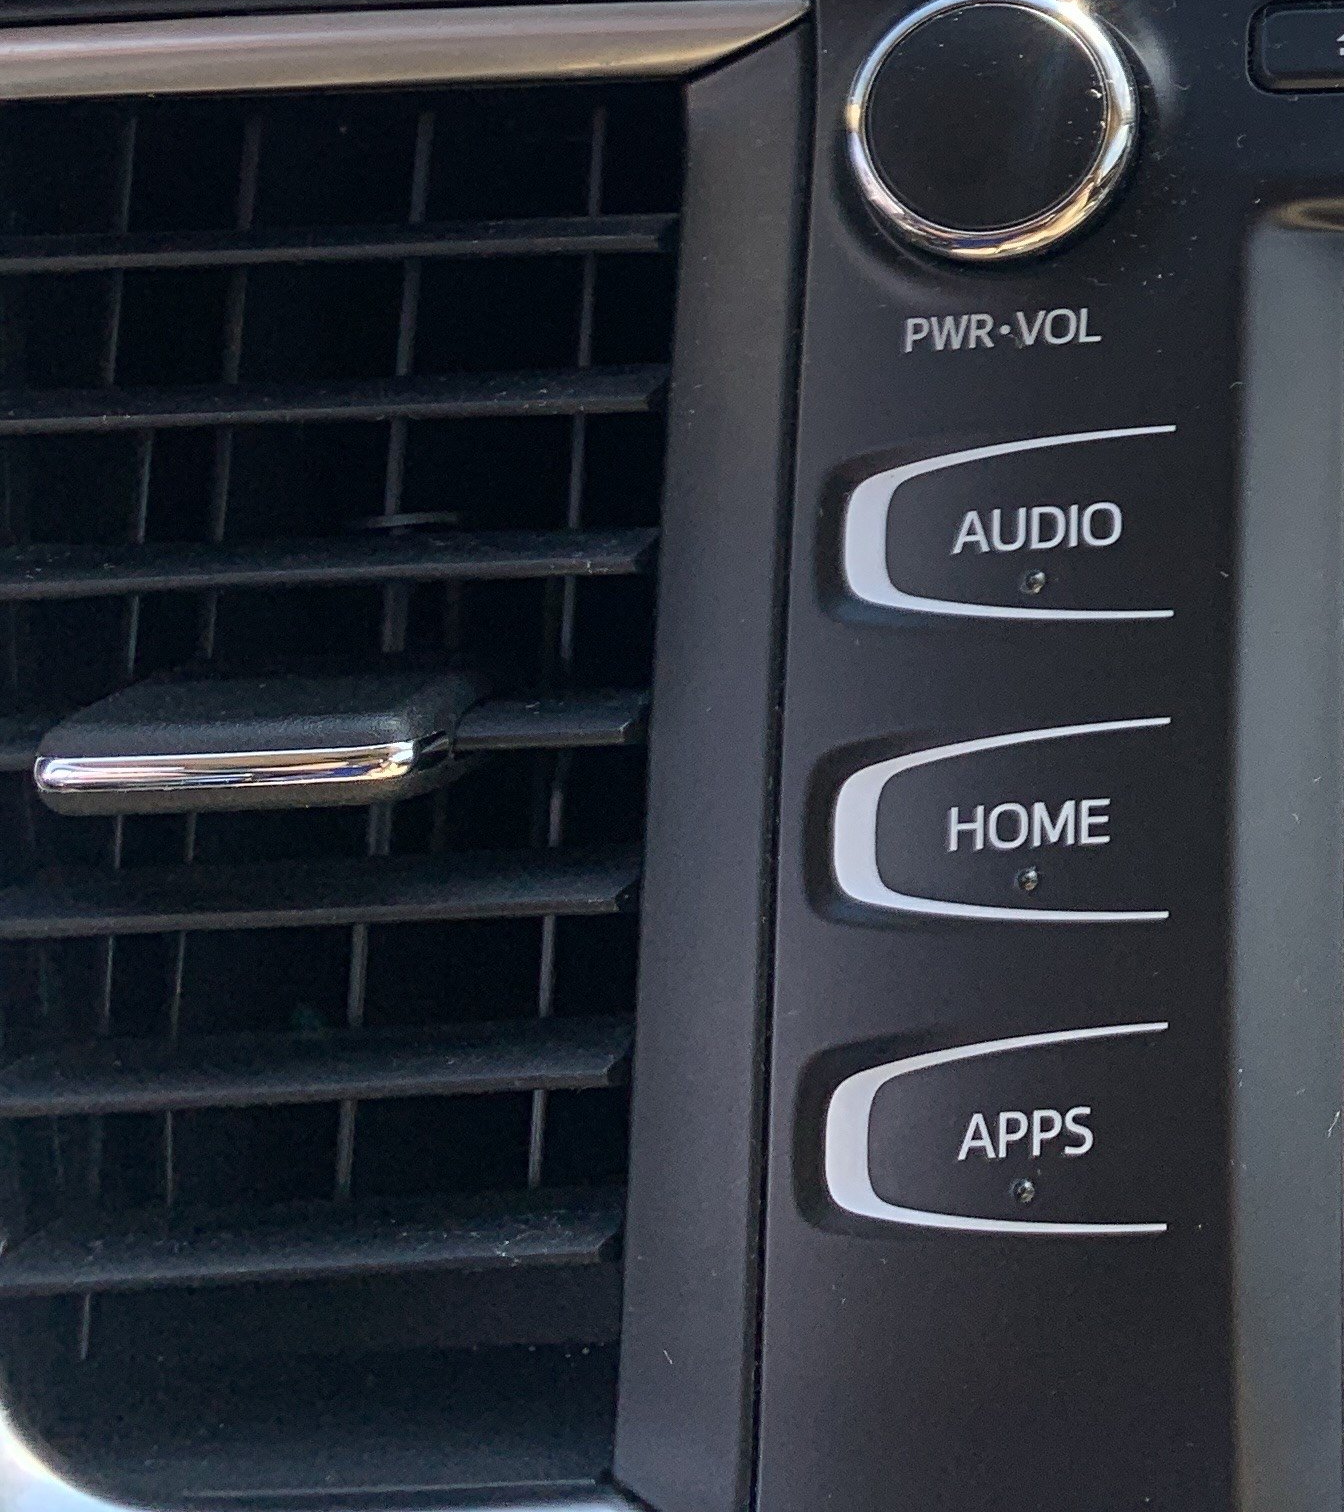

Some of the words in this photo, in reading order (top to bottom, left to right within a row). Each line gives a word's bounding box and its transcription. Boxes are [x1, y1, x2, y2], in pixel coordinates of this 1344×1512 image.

[950, 501, 1123, 555] AUDIO
[948, 798, 1111, 852] HOME
[958, 1106, 1095, 1161] APPS
